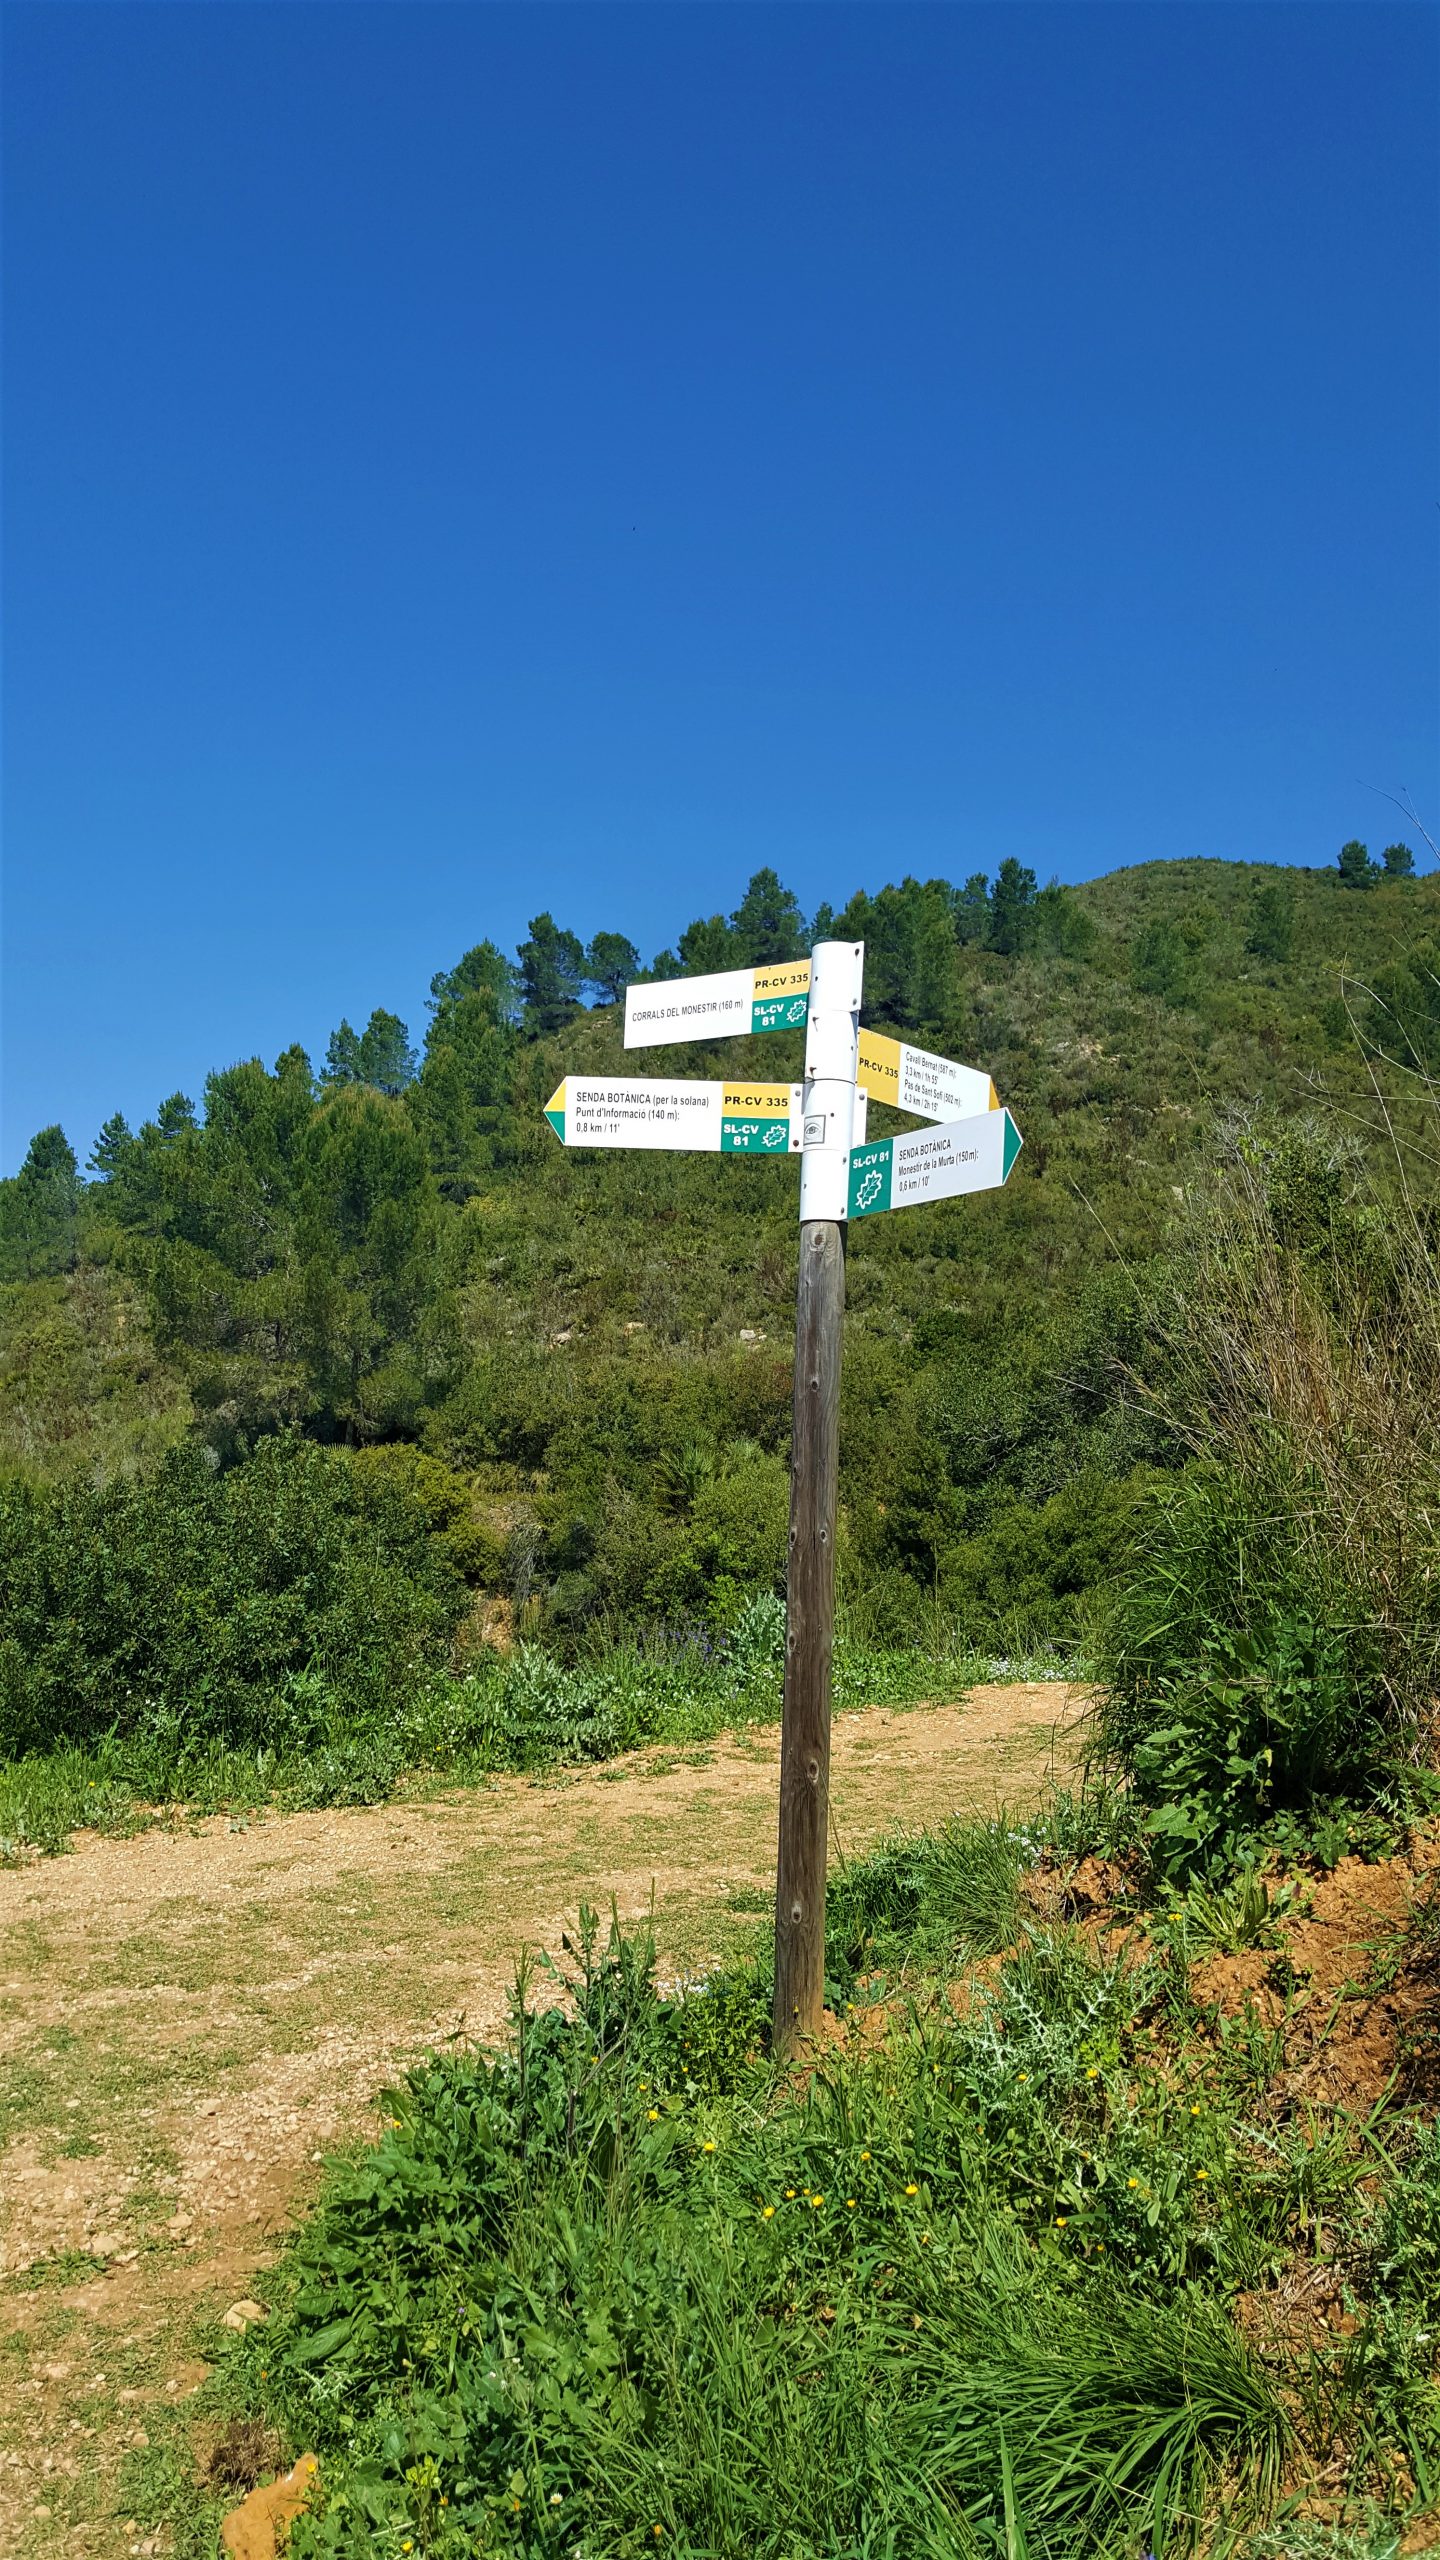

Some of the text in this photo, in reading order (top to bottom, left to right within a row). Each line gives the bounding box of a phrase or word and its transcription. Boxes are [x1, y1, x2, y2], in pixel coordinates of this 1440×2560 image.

[755, 973, 808, 989] PR-CV 335
[632, 999, 743, 1022] CORRALS DEL MONESTIR (160 m)
[754, 1004, 784, 1016] SL-CV
[762, 1016, 775, 1025] 81
[859, 1058, 898, 1078] PR-CV 335
[906, 1052, 921, 1064] Cavall
[922, 1057, 937, 1070] Bernat
[938, 1061, 948, 1075] (587
[913, 1069, 921, 1077] km
[925, 1073, 931, 1082] 1h
[576, 1091, 709, 1106] SENDA BOTÀNICA (per la solana)
[905, 1080, 914, 1089] Pas
[915, 1082, 920, 1092] de
[922, 1085, 933, 1096] Sant
[934, 1088, 943, 1100] Sofi
[944, 1092, 953, 1105] (502
[724, 1096, 788, 1106] PR-CV 335
[904, 1095, 912, 1105] 4,3
[913, 1098, 921, 1106] km
[924, 1100, 930, 1110] 2h
[576, 1107, 594, 1118] Punt
[596, 1108, 646, 1119] d'Informació
[648, 1110, 665, 1120] (140
[576, 1123, 588, 1133] 0,8
[590, 1123, 602, 1132] km
[724, 1124, 759, 1134] SL-CV
[733, 1137, 748, 1146] 81
[899, 1139, 951, 1160] SENDA BOTÀNICA
[853, 1151, 889, 1168] SL-CV 81
[899, 1162, 922, 1176] Monestir
[924, 1161, 930, 1171] de
[932, 1160, 937, 1169] la
[938, 1155, 954, 1168] Murta
[899, 1181, 907, 1192] 0,6
[908, 1180, 917, 1189] km
